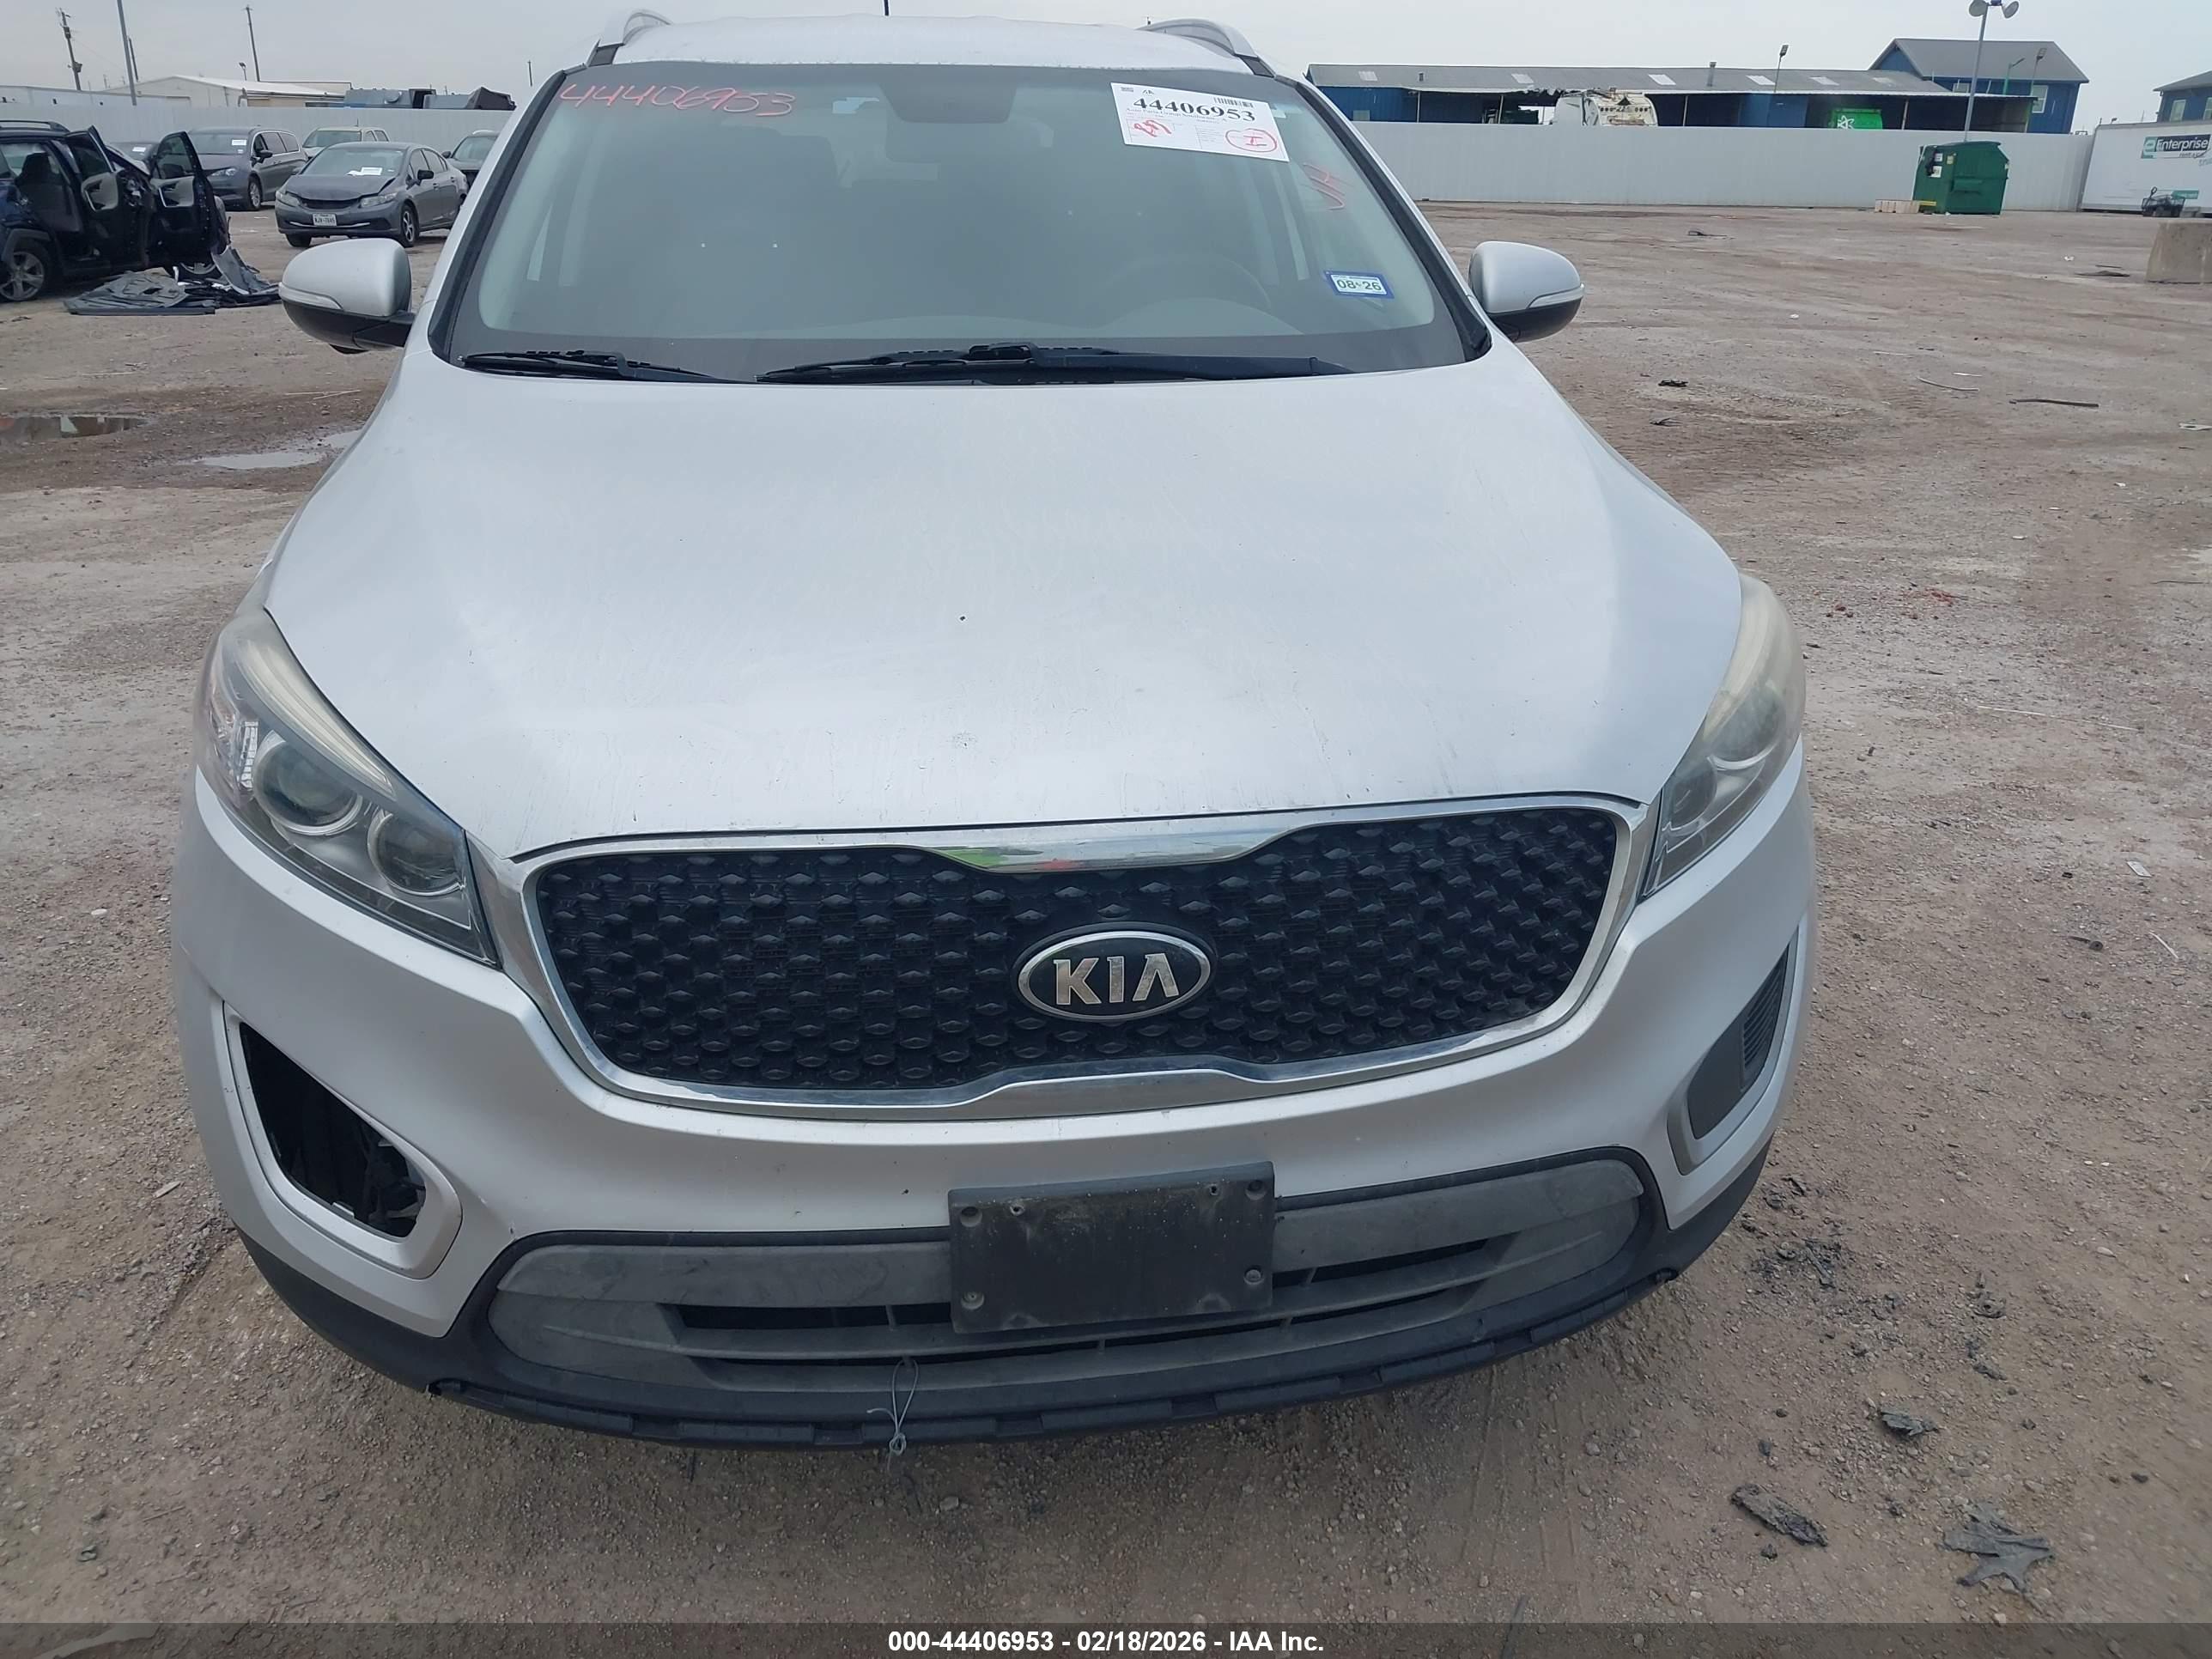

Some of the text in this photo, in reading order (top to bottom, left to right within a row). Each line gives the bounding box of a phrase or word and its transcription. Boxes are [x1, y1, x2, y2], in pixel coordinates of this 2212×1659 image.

[560, 83, 797, 117] 44406953
[1133, 97, 1256, 122] 44406953
[2157, 137, 2209, 151] Enterprise
[1053, 952, 1180, 1006] KIA
